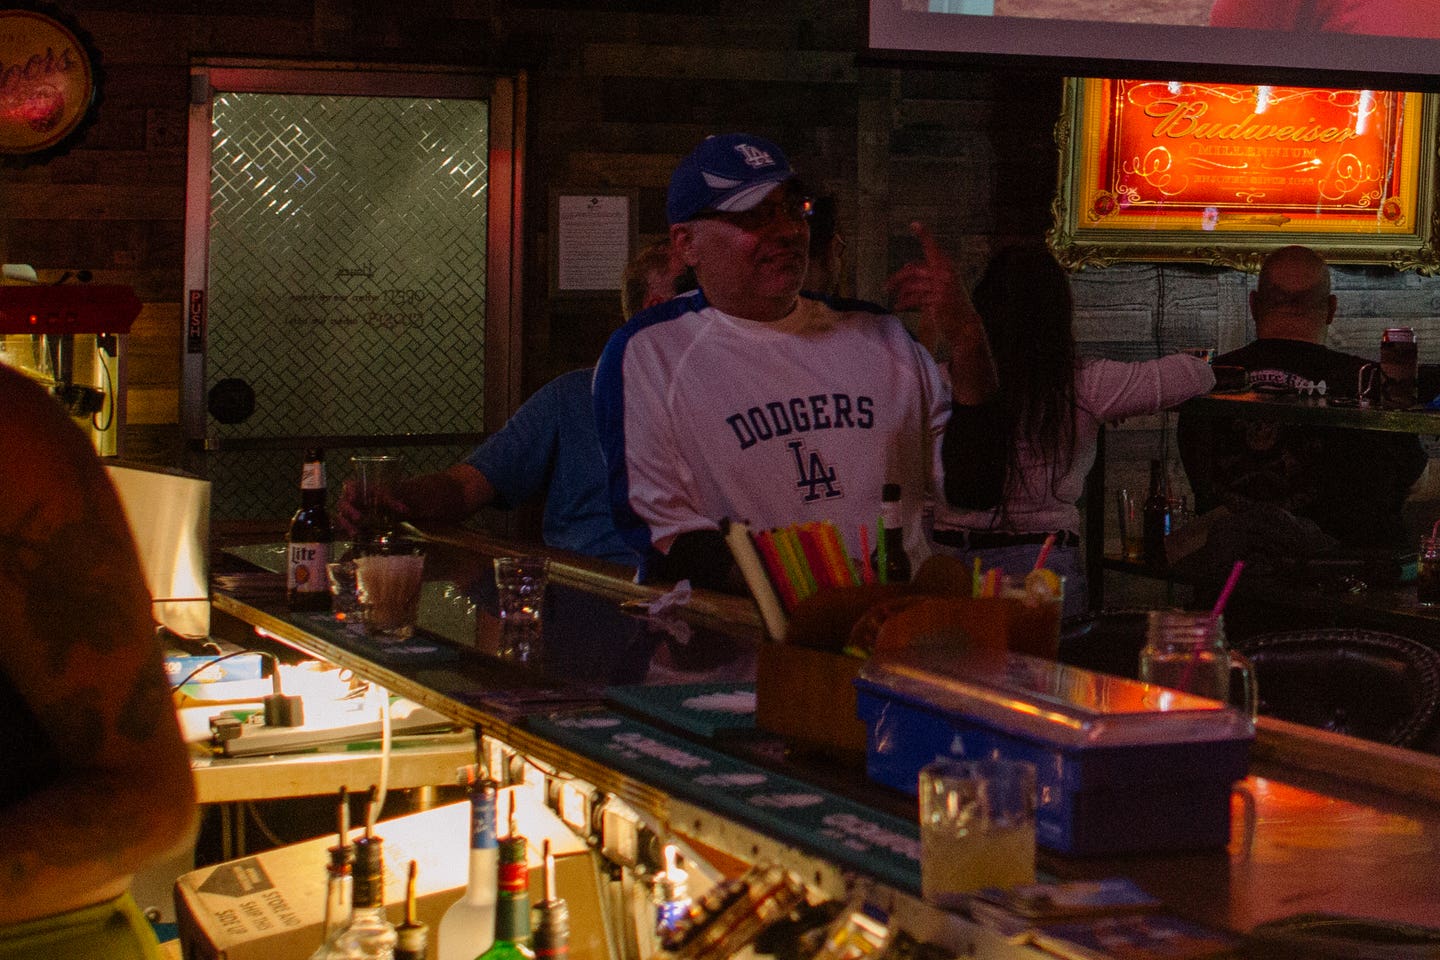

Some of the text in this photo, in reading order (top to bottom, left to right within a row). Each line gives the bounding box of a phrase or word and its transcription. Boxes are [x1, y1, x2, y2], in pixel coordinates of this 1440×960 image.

[1144, 100, 1361, 143] Budweiser
[734, 144, 776, 169] LA
[190, 291, 201, 337] PUSH
[726, 393, 875, 451] DODGERS
[787, 440, 842, 502] LA
[291, 547, 316, 564] Lite
